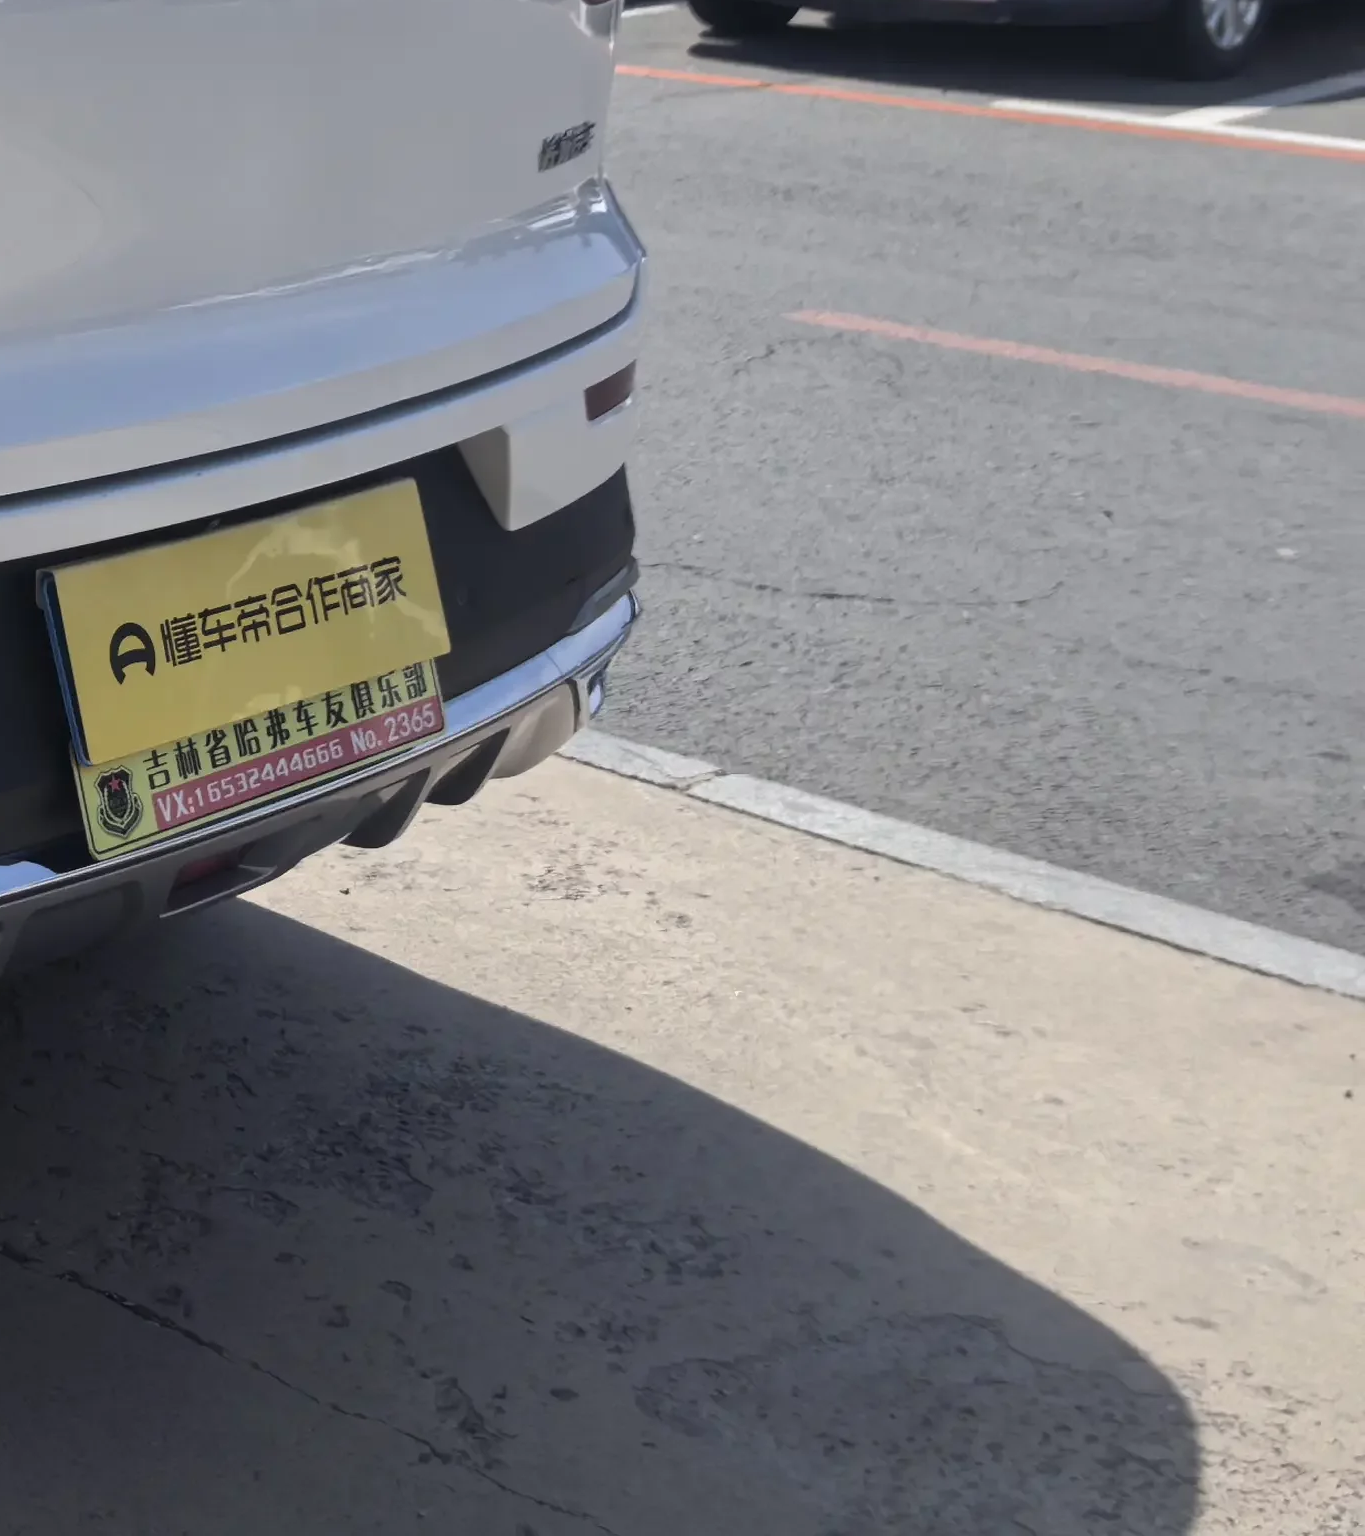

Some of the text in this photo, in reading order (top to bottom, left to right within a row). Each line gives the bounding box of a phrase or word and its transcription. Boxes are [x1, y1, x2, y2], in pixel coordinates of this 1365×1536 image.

[160, 555, 407, 667] 懂车帝合作商家
